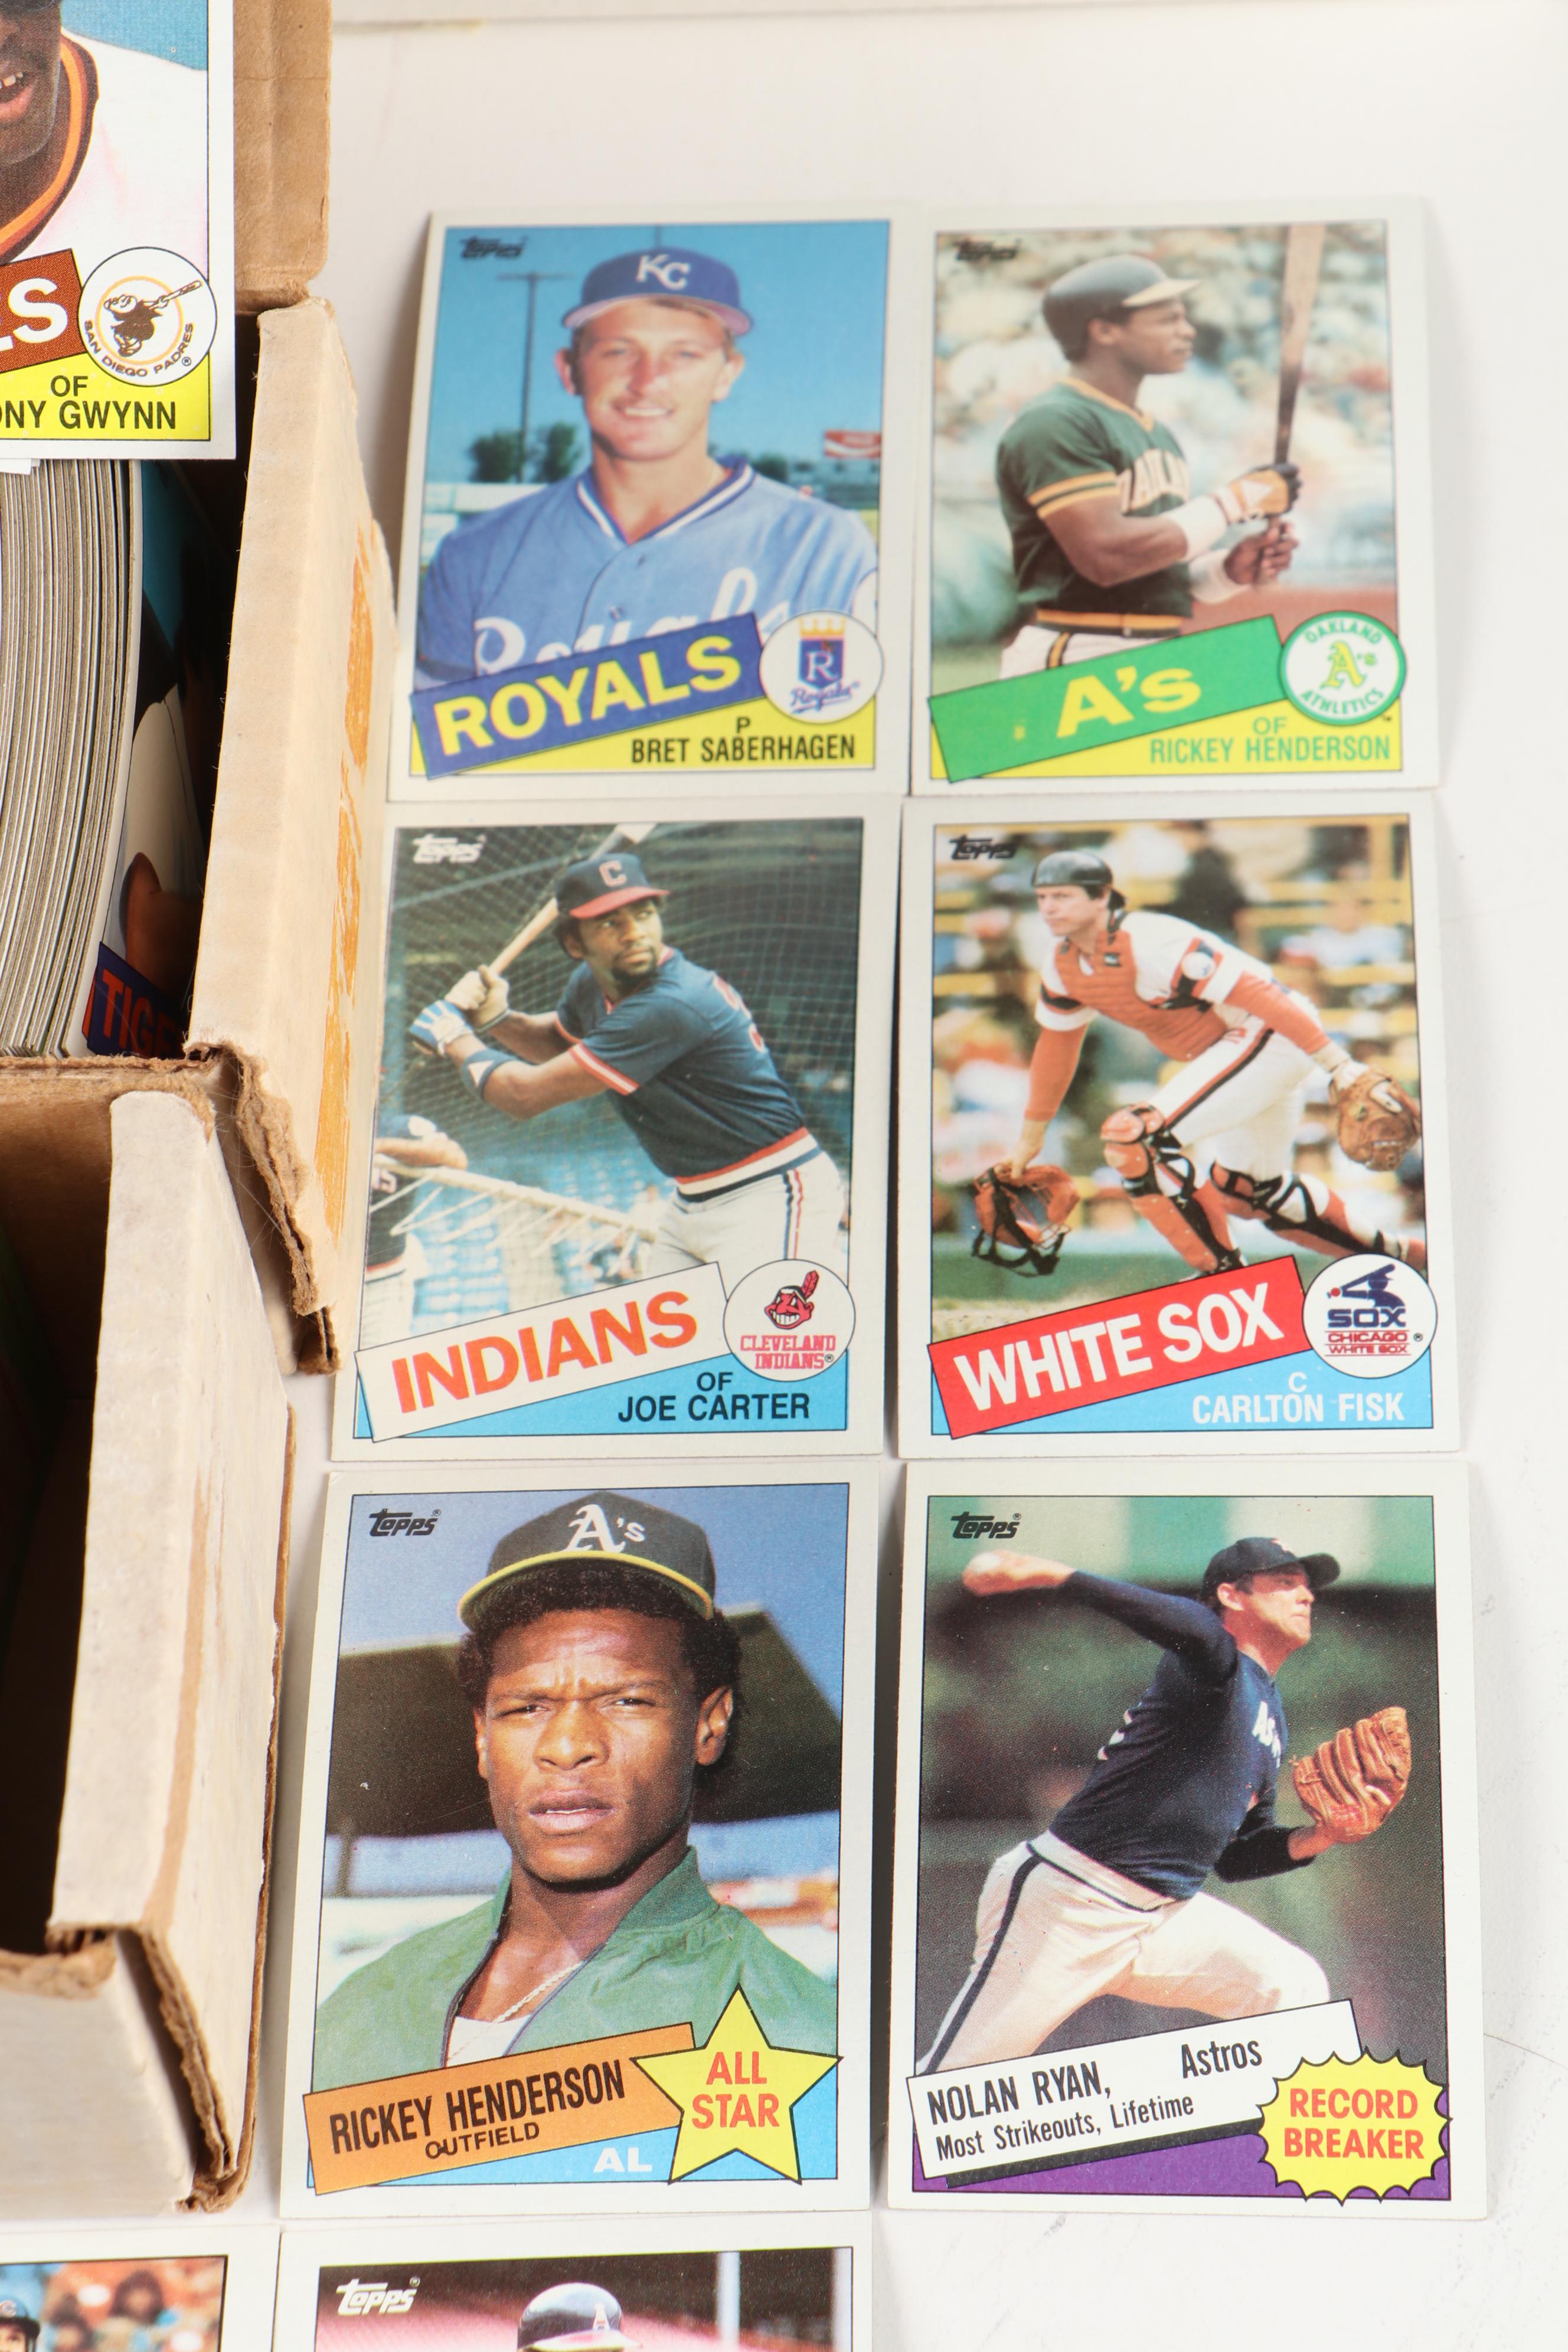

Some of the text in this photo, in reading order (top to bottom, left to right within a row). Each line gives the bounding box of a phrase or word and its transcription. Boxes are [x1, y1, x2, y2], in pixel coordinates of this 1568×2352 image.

[636, 254, 690, 289] KC
[84, 319, 194, 377] SAN DIEGO PADRES
[50, 375, 88, 397] OF
[0, 400, 176, 429] NY GWYNN
[1305, 621, 1382, 644] OAKLAND
[806, 651, 838, 681] R
[434, 636, 741, 756] ROYALS
[1301, 687, 1384, 714] ATHLETICS
[737, 716, 750, 733] P
[1253, 717, 1287, 736] OF
[632, 734, 855, 764] BRET SABERHAGEN
[1150, 734, 1390, 763] RICKEY HENDERSON
[599, 860, 627, 887] C
[1328, 1308, 1406, 1328] SOX
[740, 1335, 836, 1351] CLEVELAND
[953, 1282, 1284, 1411] WHITE SOX
[1328, 1331, 1408, 1342] CHICAGO
[1328, 1344, 1374, 1354] WHITE
[391, 1291, 697, 1413] INDIANS
[755, 1353, 824, 1369] INDIANS
[696, 1372, 733, 1392] OF
[1289, 1372, 1307, 1393] C
[618, 1393, 810, 1423] JOE CARTER
[1193, 1393, 1404, 1424] CARLTON FISK
[705, 2051, 767, 2085] ALL
[1181, 2039, 1263, 2079] Astros
[329, 2059, 625, 2155] RICKEY HENDERSON
[927, 2060, 1112, 2126] NOLAN RYAN,
[1290, 2088, 1418, 2119] RECORD
[692, 2093, 779, 2129] STAR
[425, 2122, 540, 2160] OUTFIELD
[936, 2095, 1194, 2161] Most Strikeouts, Lifetime
[1284, 2127, 1425, 2160] BREAKER
[593, 2147, 652, 2173] AL
